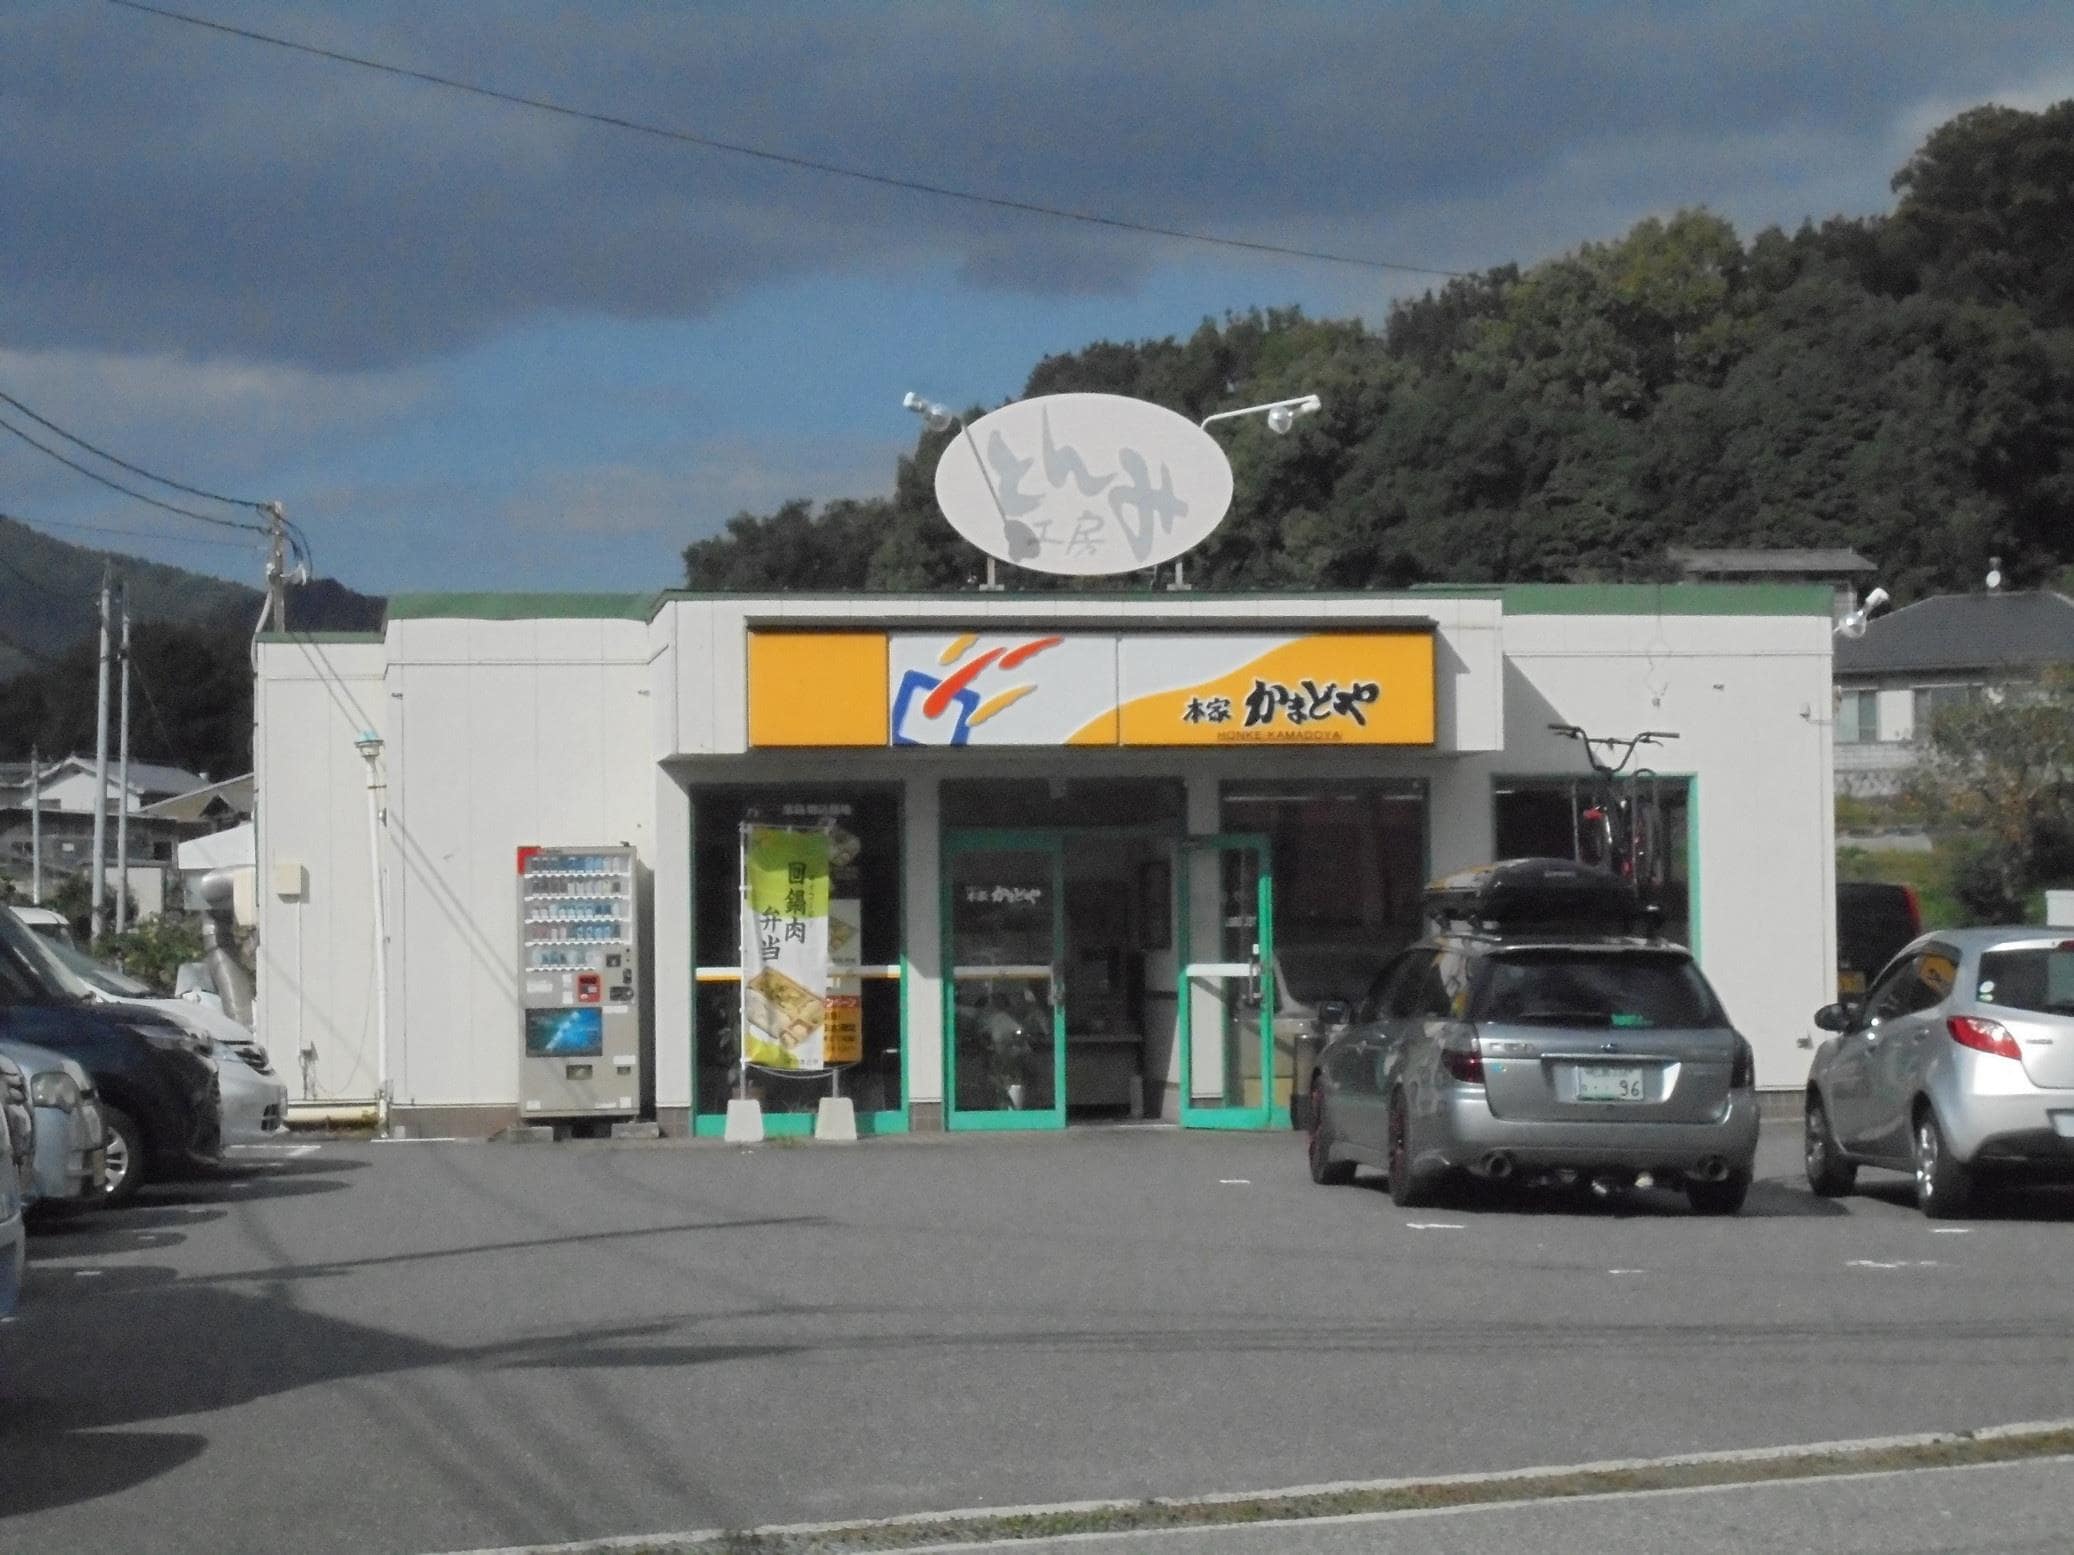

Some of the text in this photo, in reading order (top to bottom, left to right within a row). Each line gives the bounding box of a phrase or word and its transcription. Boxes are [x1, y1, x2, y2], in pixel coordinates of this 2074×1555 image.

[1183, 679, 1380, 727] 本家 かまどや
[1216, 731, 1342, 741] HONKE KAMADOYA
[785, 862, 806, 944] 回鍋肉
[760, 905, 782, 962] 弁当
